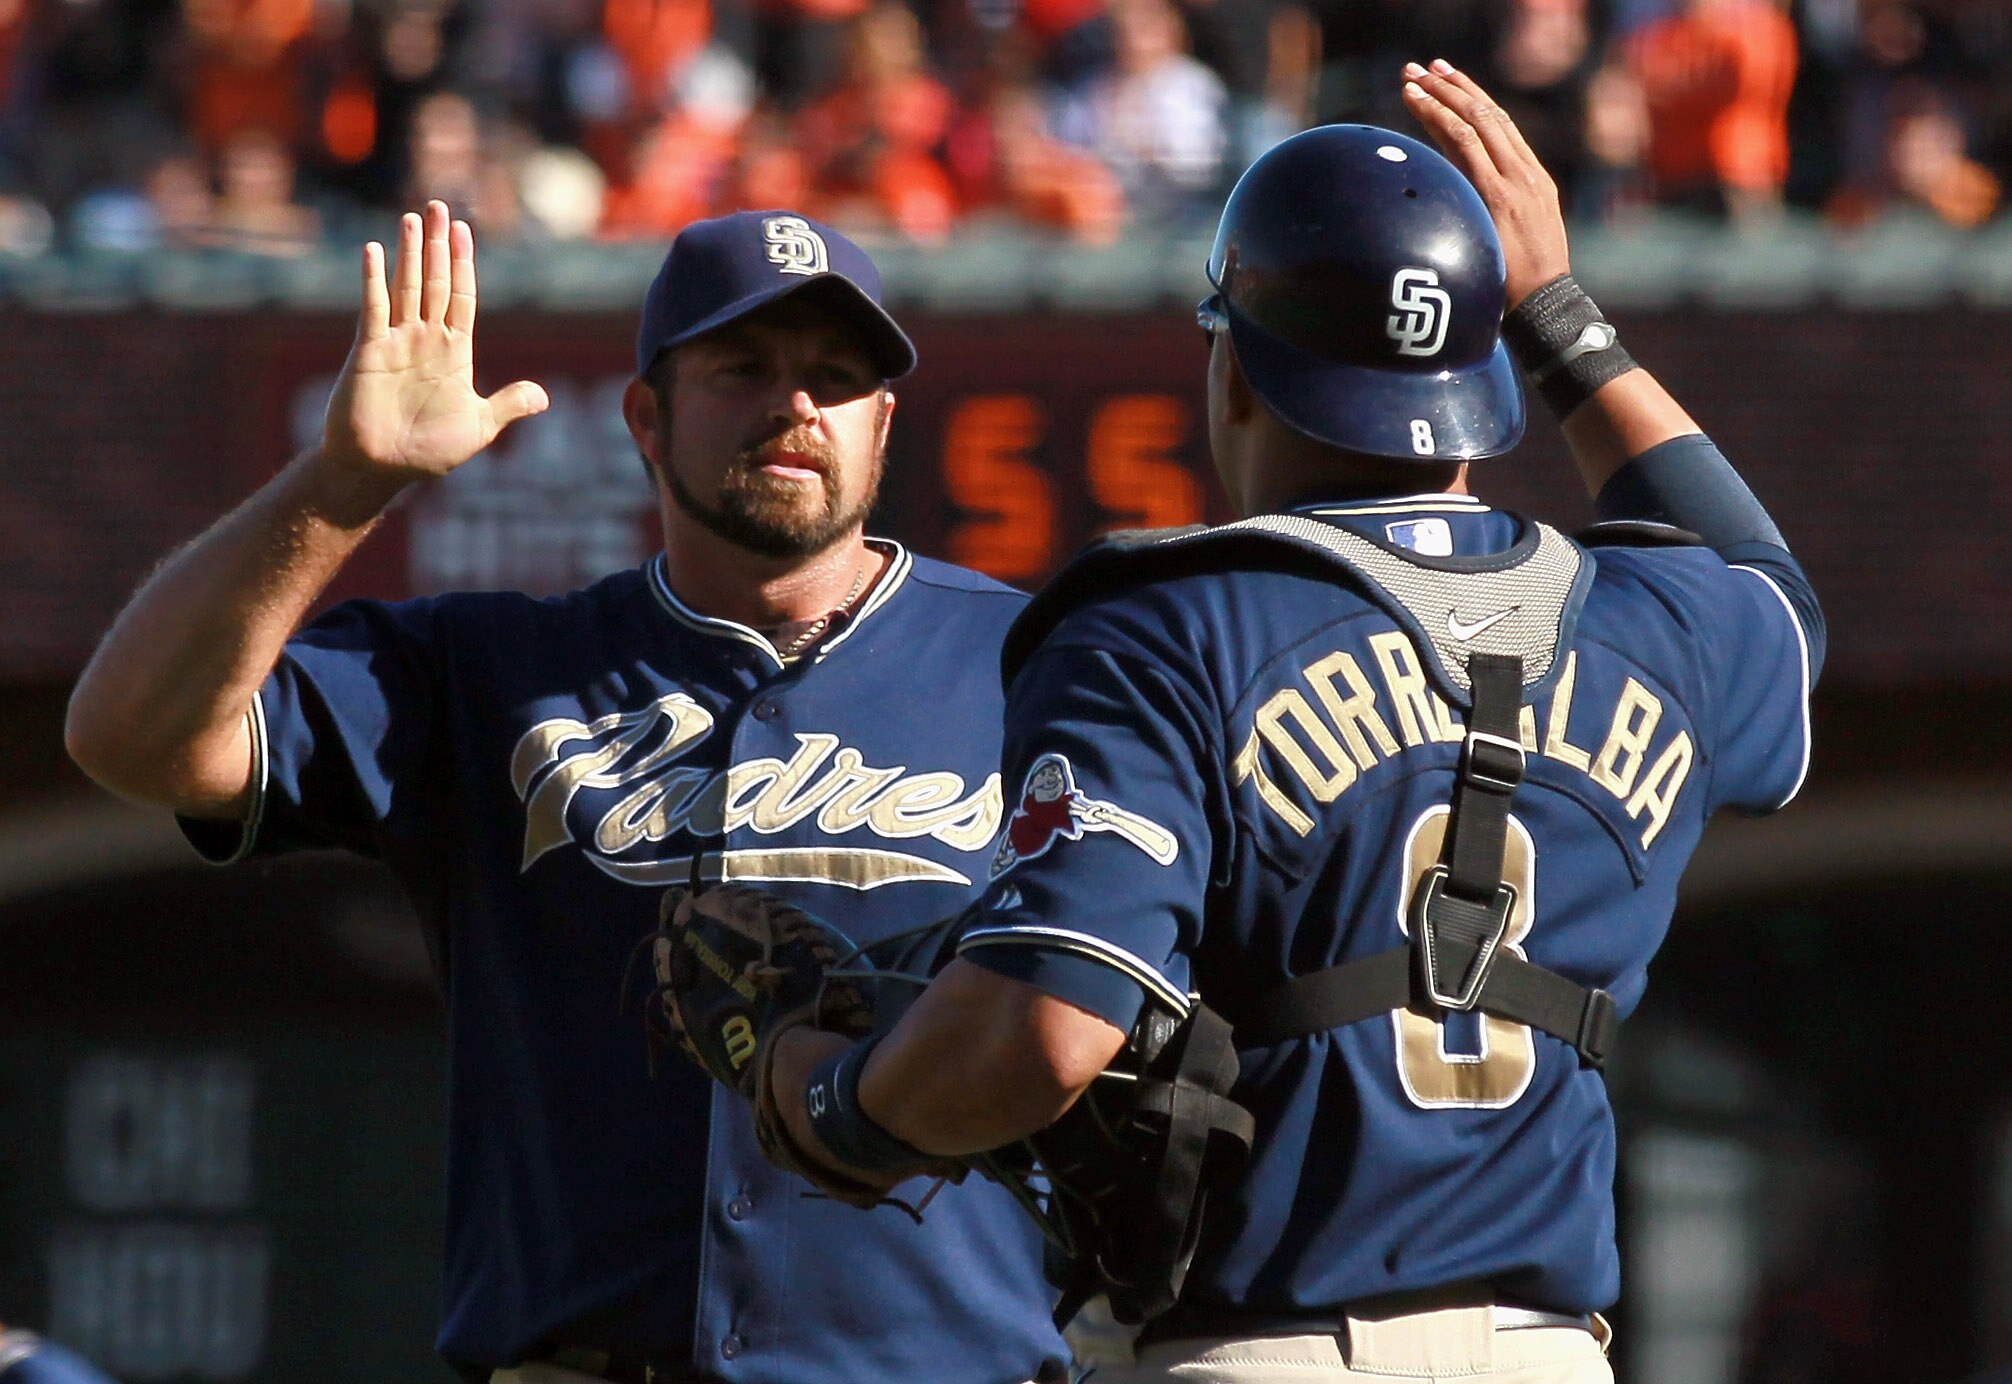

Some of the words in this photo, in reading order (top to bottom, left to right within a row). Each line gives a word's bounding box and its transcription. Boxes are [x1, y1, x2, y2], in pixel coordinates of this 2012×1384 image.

[762, 215, 829, 275] SD
[1386, 267, 1452, 357] SD
[1410, 419, 1436, 456] 8
[1229, 631, 1693, 851] TORRLBA
[510, 692, 1003, 874] Padres
[809, 1084, 826, 1118] 8
